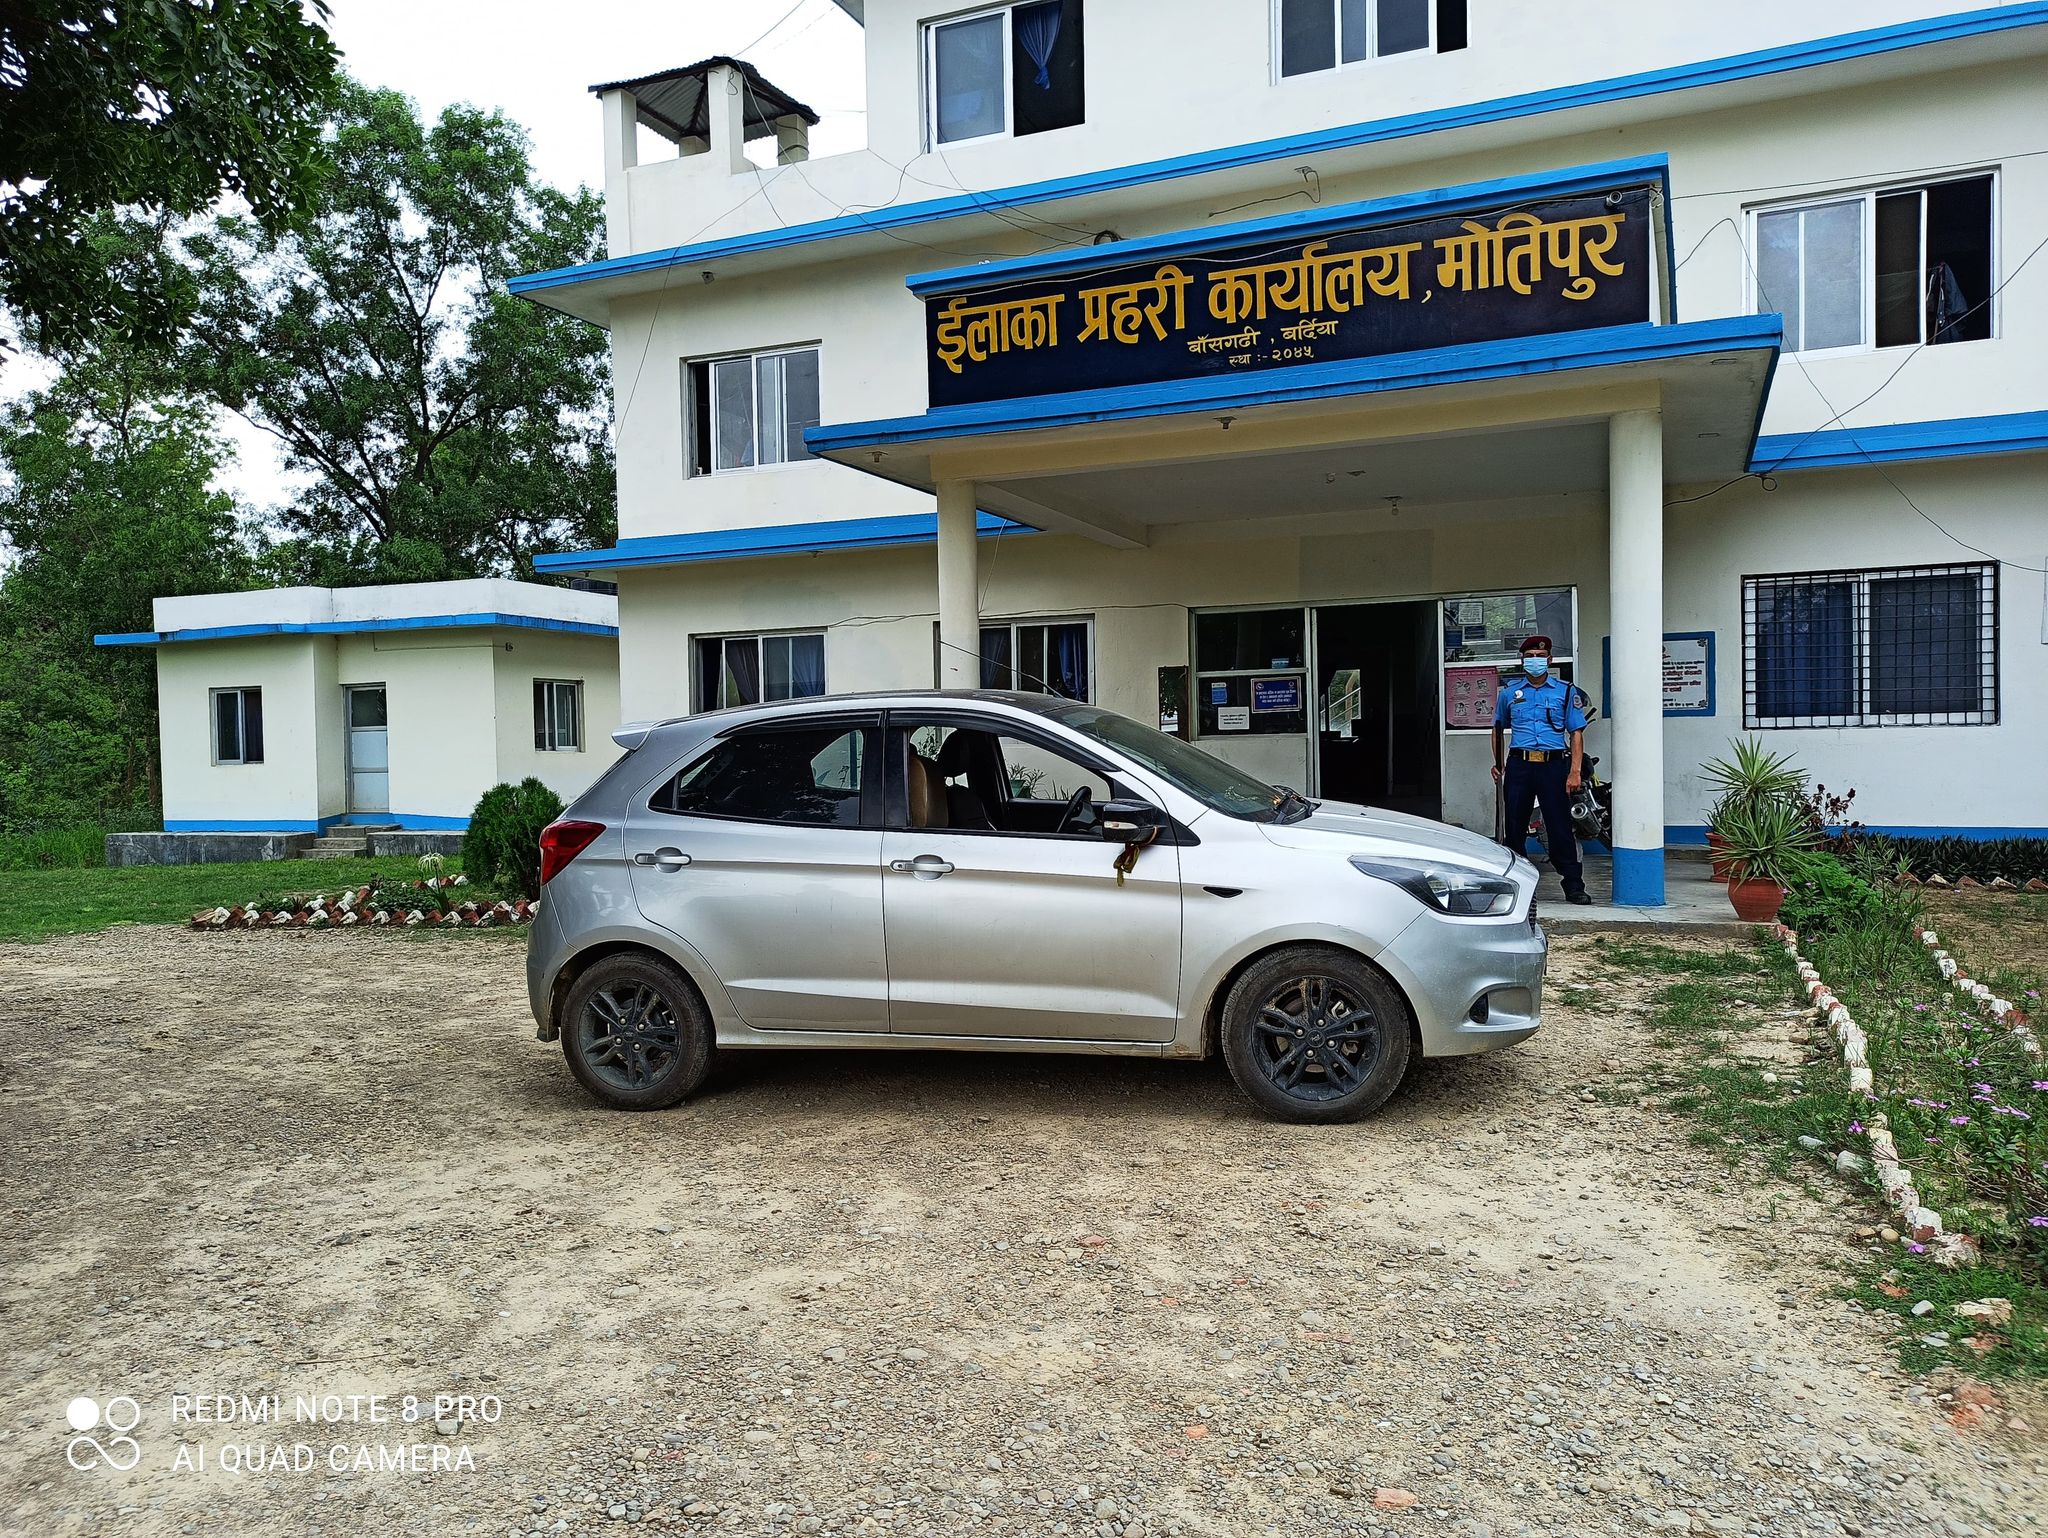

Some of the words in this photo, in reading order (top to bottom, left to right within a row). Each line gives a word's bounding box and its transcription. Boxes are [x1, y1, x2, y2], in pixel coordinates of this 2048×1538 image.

[936, 293, 1065, 374] ईलाका
[1077, 264, 1194, 344] प्रहरी
[1433, 212, 1626, 300] मोतिपुर
[1280, 318, 1339, 341] बर्दिया
